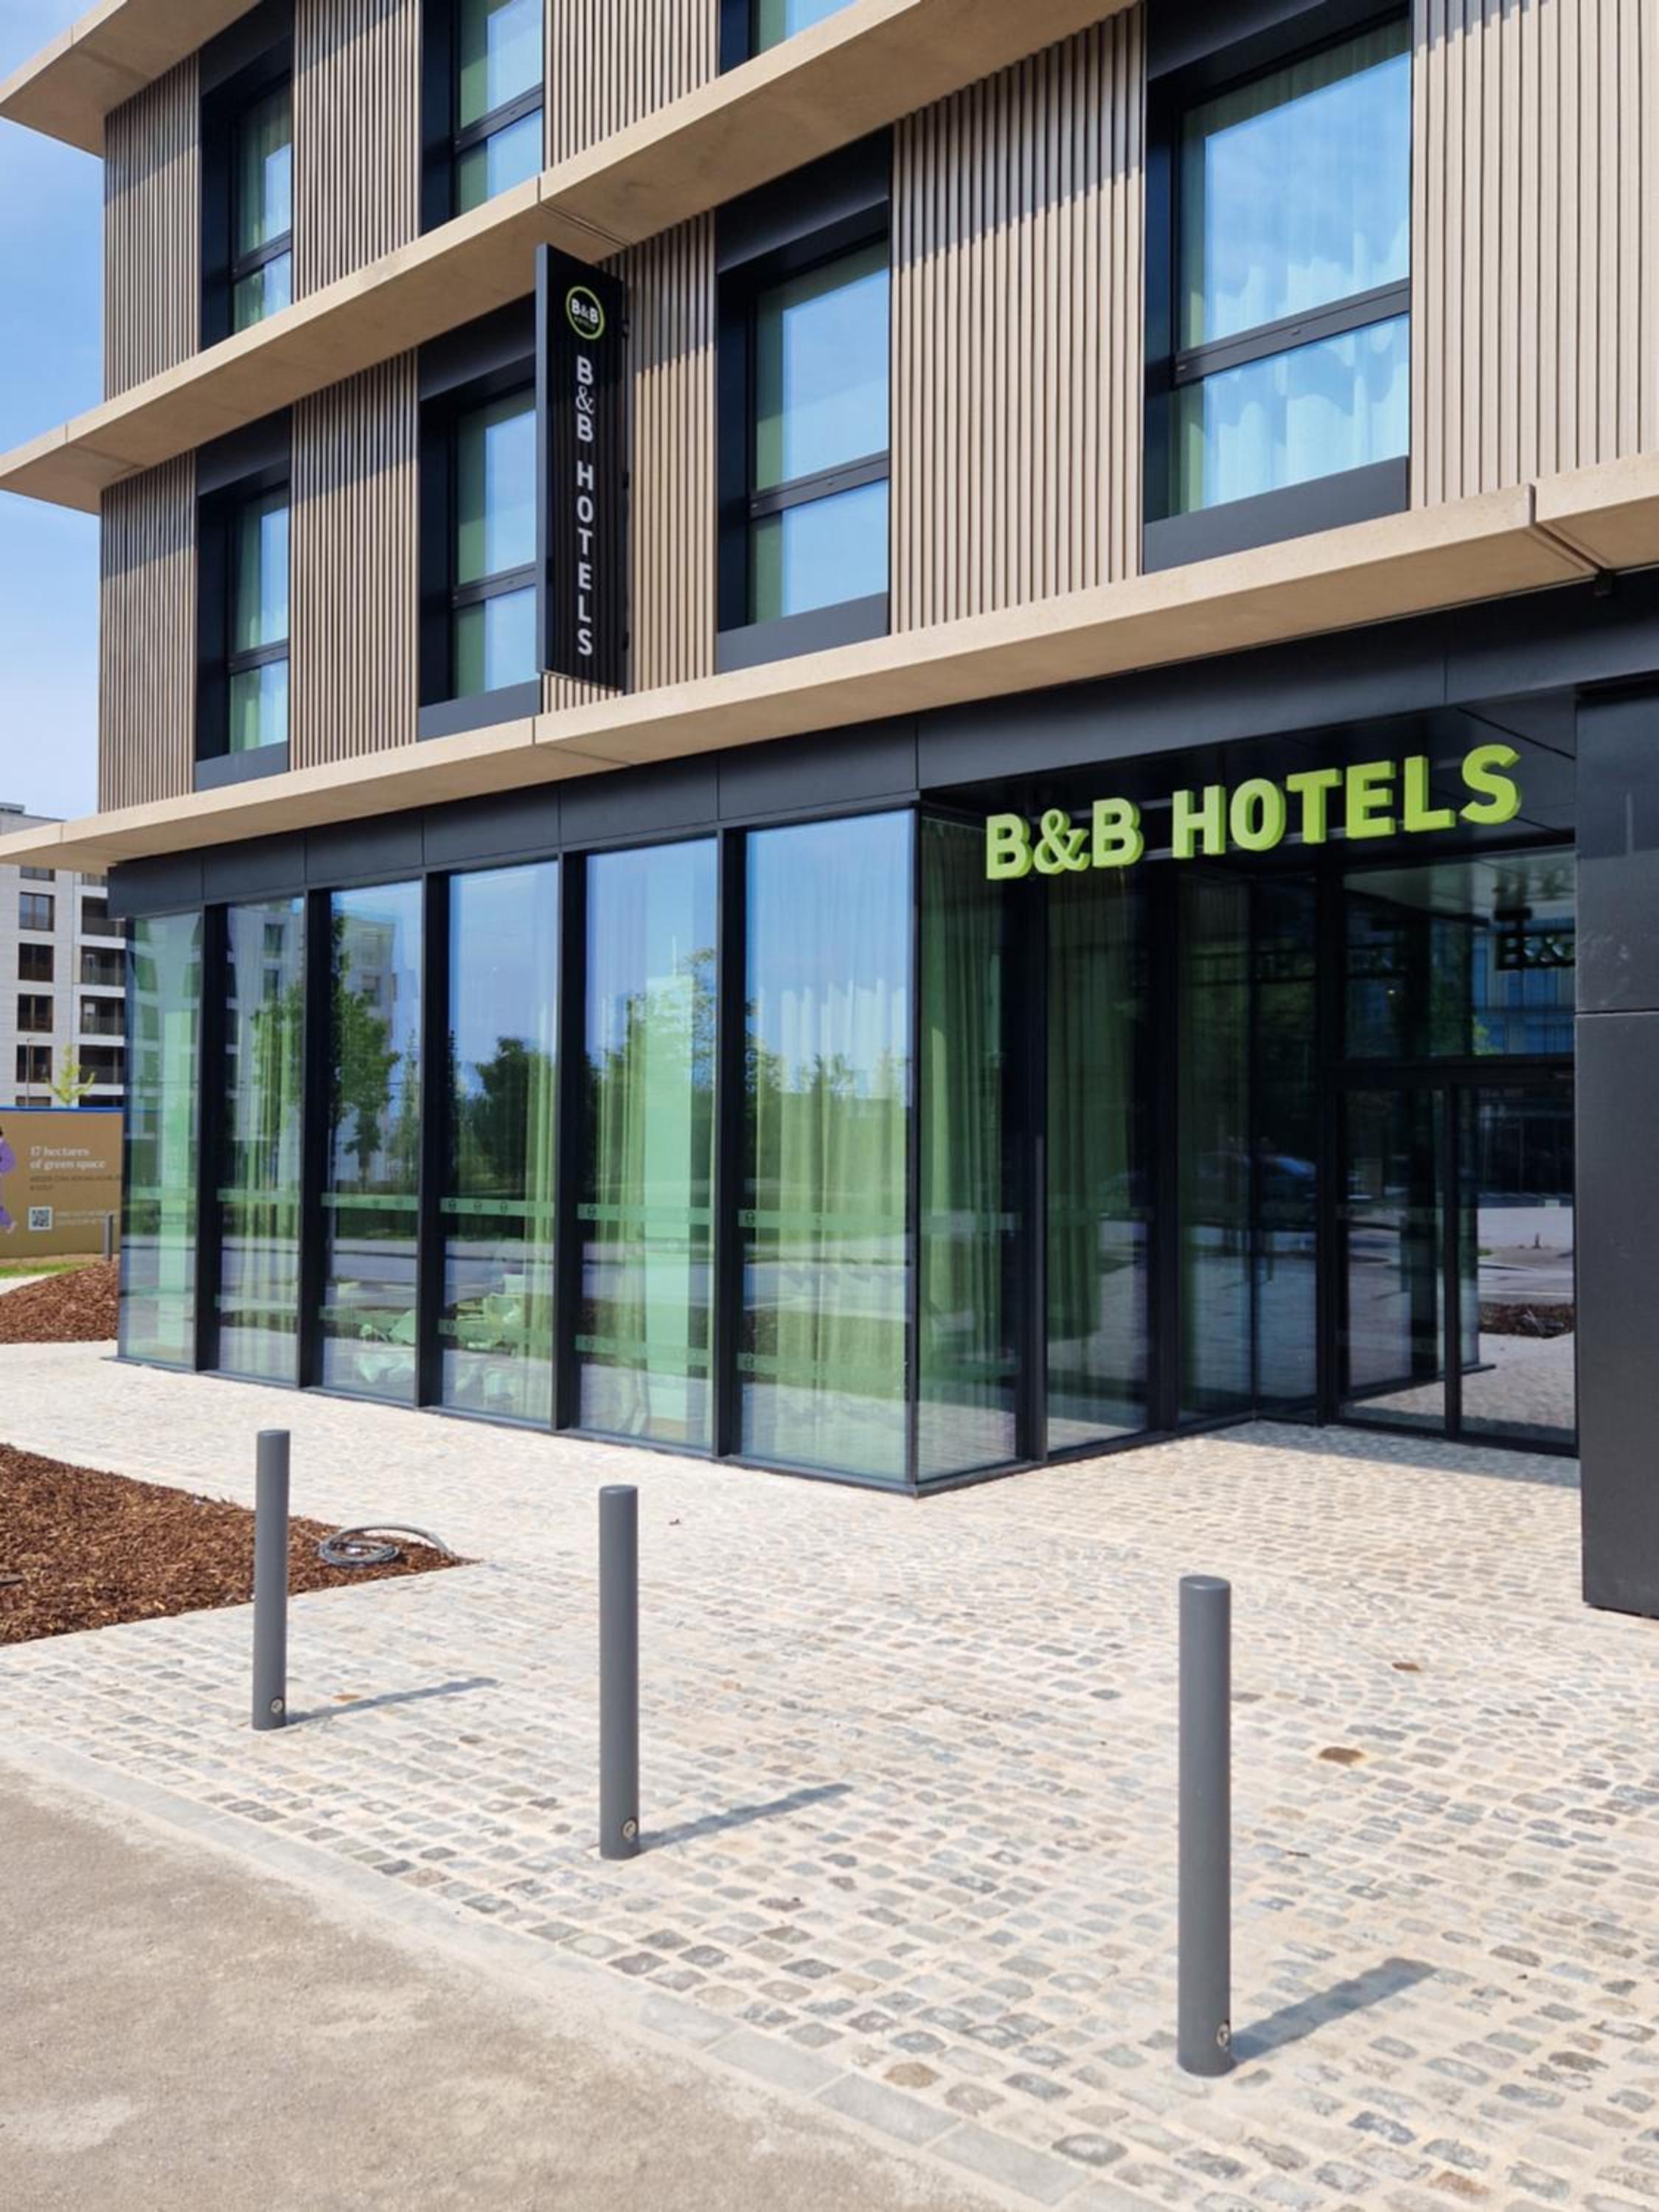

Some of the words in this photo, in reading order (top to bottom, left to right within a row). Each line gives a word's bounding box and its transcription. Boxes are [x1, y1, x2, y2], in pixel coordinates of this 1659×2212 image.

[571, 298, 599, 323] B&B
[576, 355, 594, 443] B&B
[577, 460, 594, 655] HOTELS
[987, 797, 1145, 880] B&B
[1172, 744, 1521, 860] HOTELS
[29, 1159, 42, 1169] of
[44, 1161, 74, 1172] green
[77, 1161, 106, 1172] space
[43, 1146, 90, 1157] hectares
